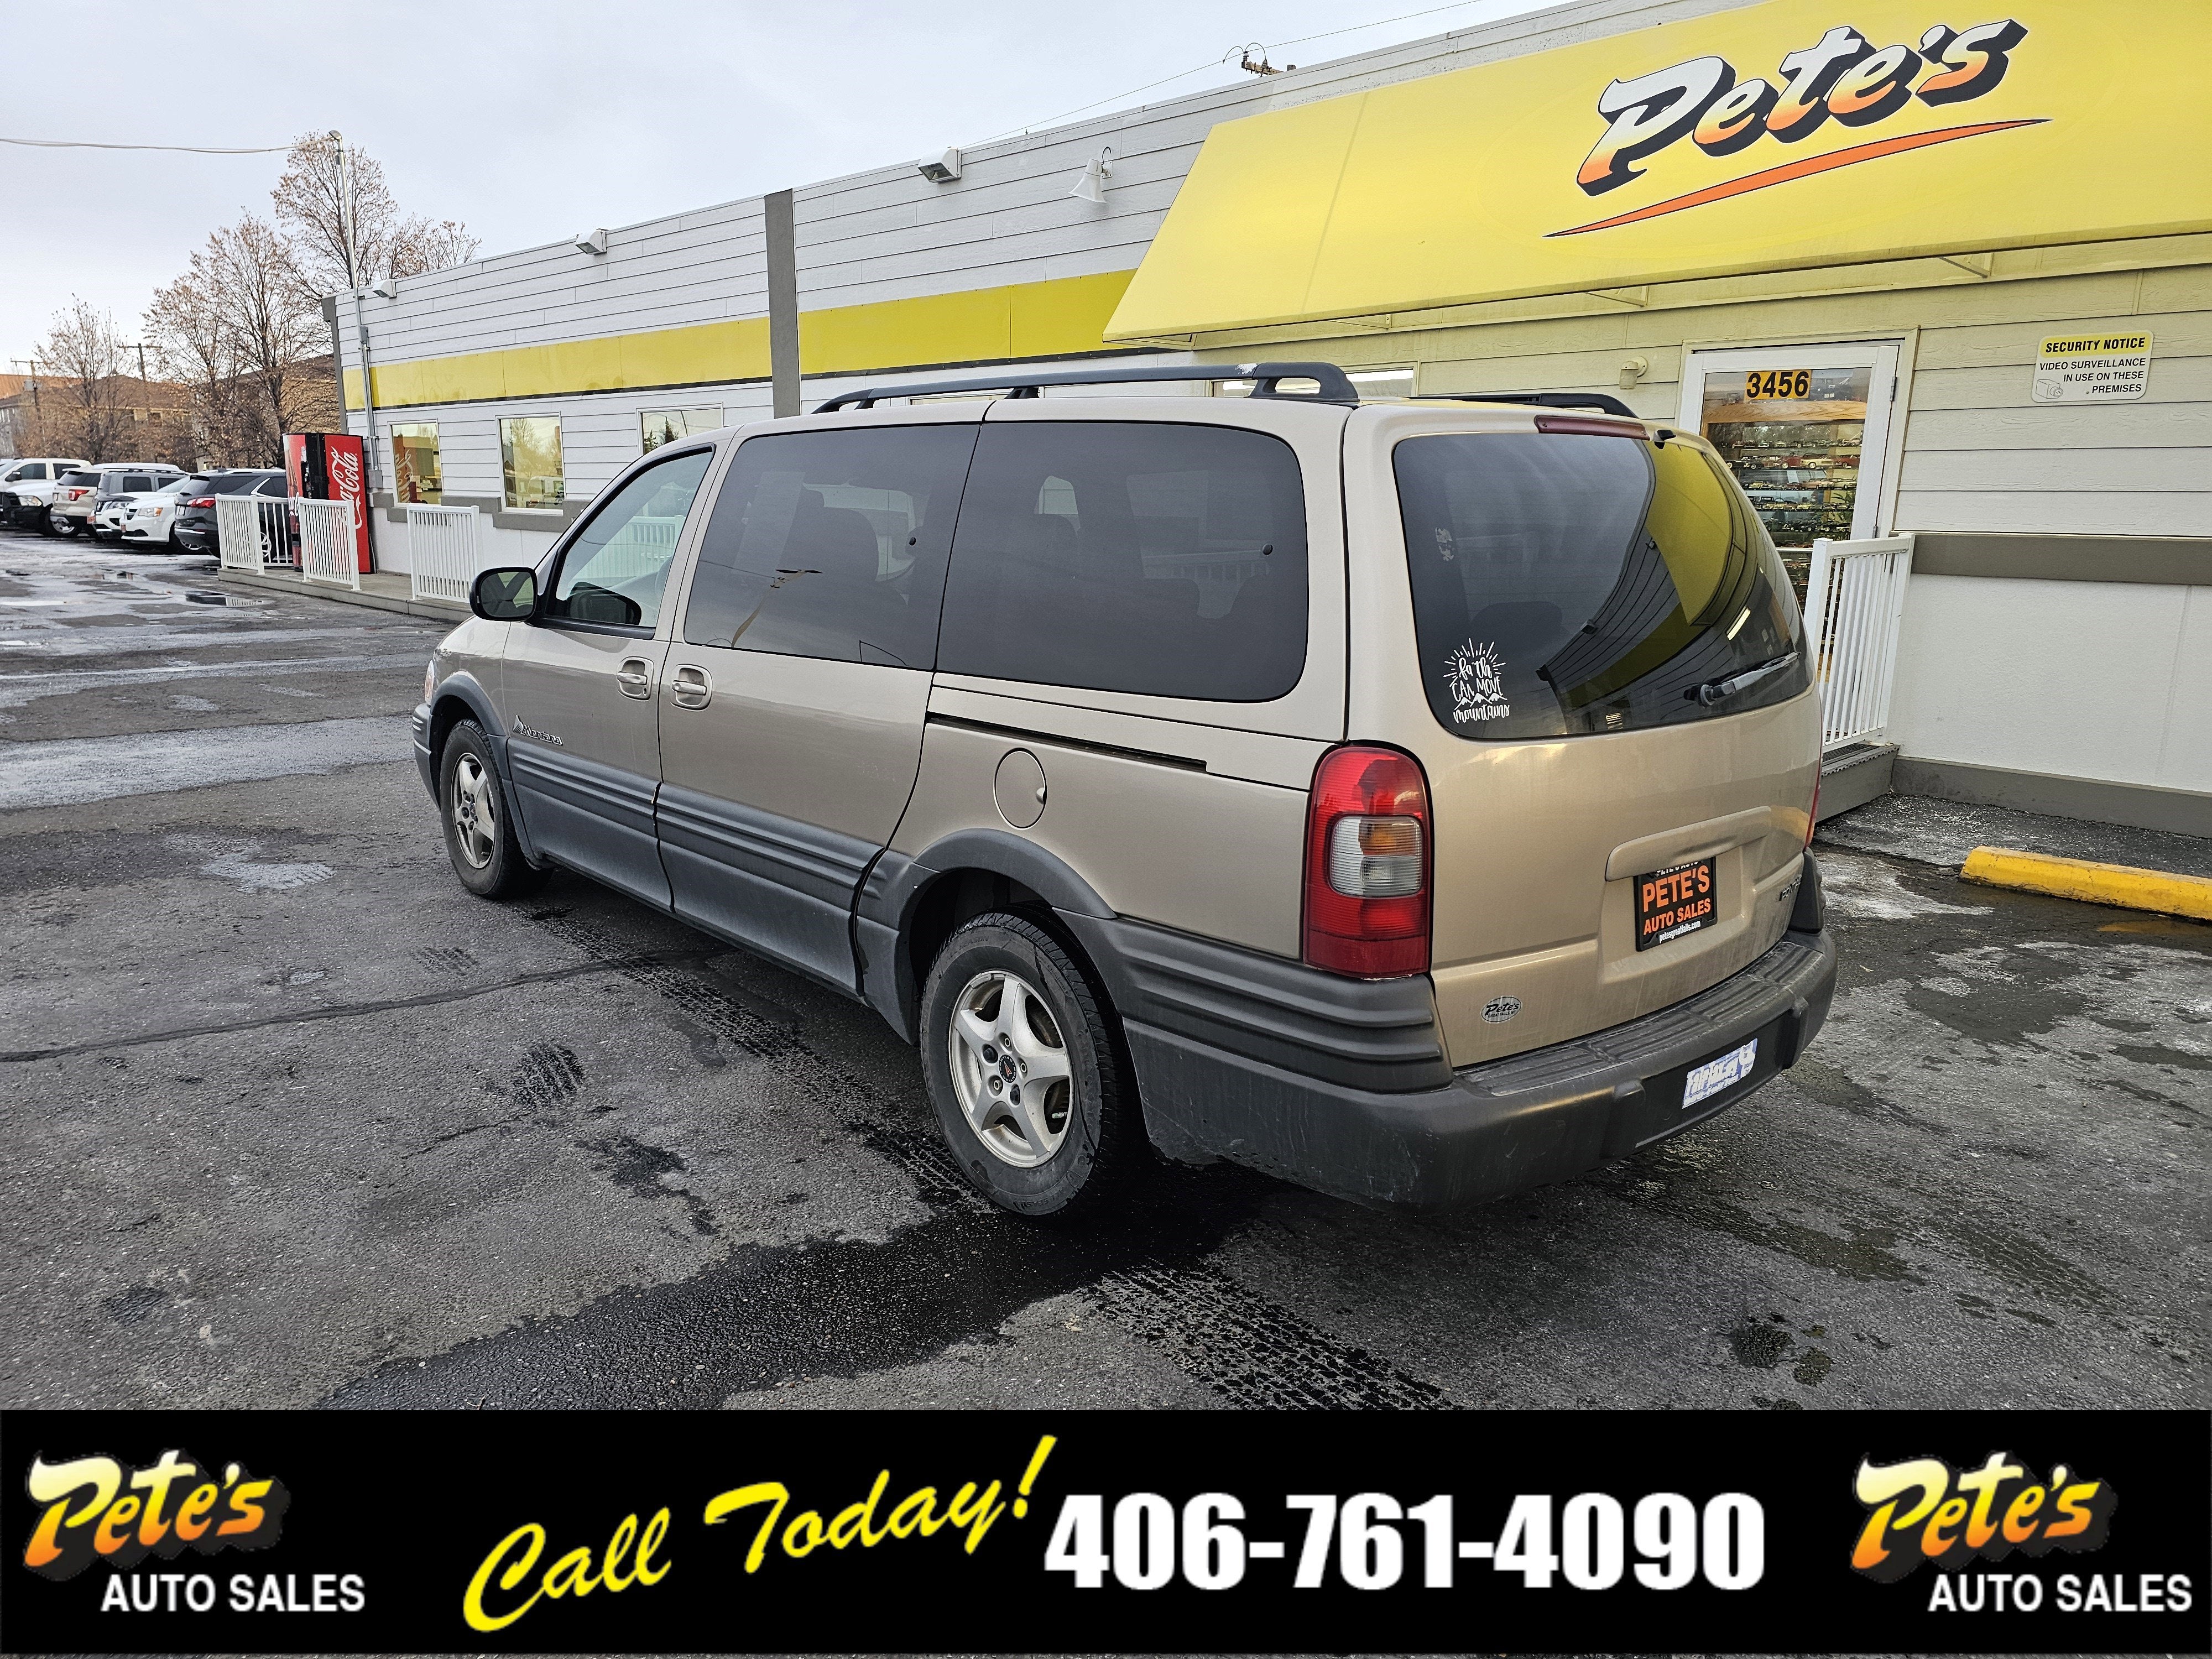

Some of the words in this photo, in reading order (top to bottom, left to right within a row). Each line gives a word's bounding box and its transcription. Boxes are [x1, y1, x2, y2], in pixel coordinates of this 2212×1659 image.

[1577, 19, 2028, 196] Pete's
[2046, 340, 2100, 353] SECURITY
[2103, 337, 2146, 349] NOTICE
[2039, 361, 2068, 371] VIDEO
[2070, 358, 2146, 369] SURVEILLANCE
[1746, 371, 1809, 398] 3456
[2063, 374, 2073, 382] IN
[2075, 373, 2094, 382] USE
[2096, 372, 2110, 380] ON
[2113, 371, 2144, 380] THESE
[2091, 383, 2142, 394] PREMISES
[1452, 680, 1474, 702] CAN
[1476, 676, 1504, 696] MOVE
[1453, 703, 1510, 723] mountains
[1642, 865, 1710, 912] PETE'S
[1643, 911, 1674, 936] AUTO
[1677, 898, 1711, 922] SALES
[1659, 920, 1701, 944] petesgreatfalls.com
[1484, 1002, 1520, 1016] Pete's
